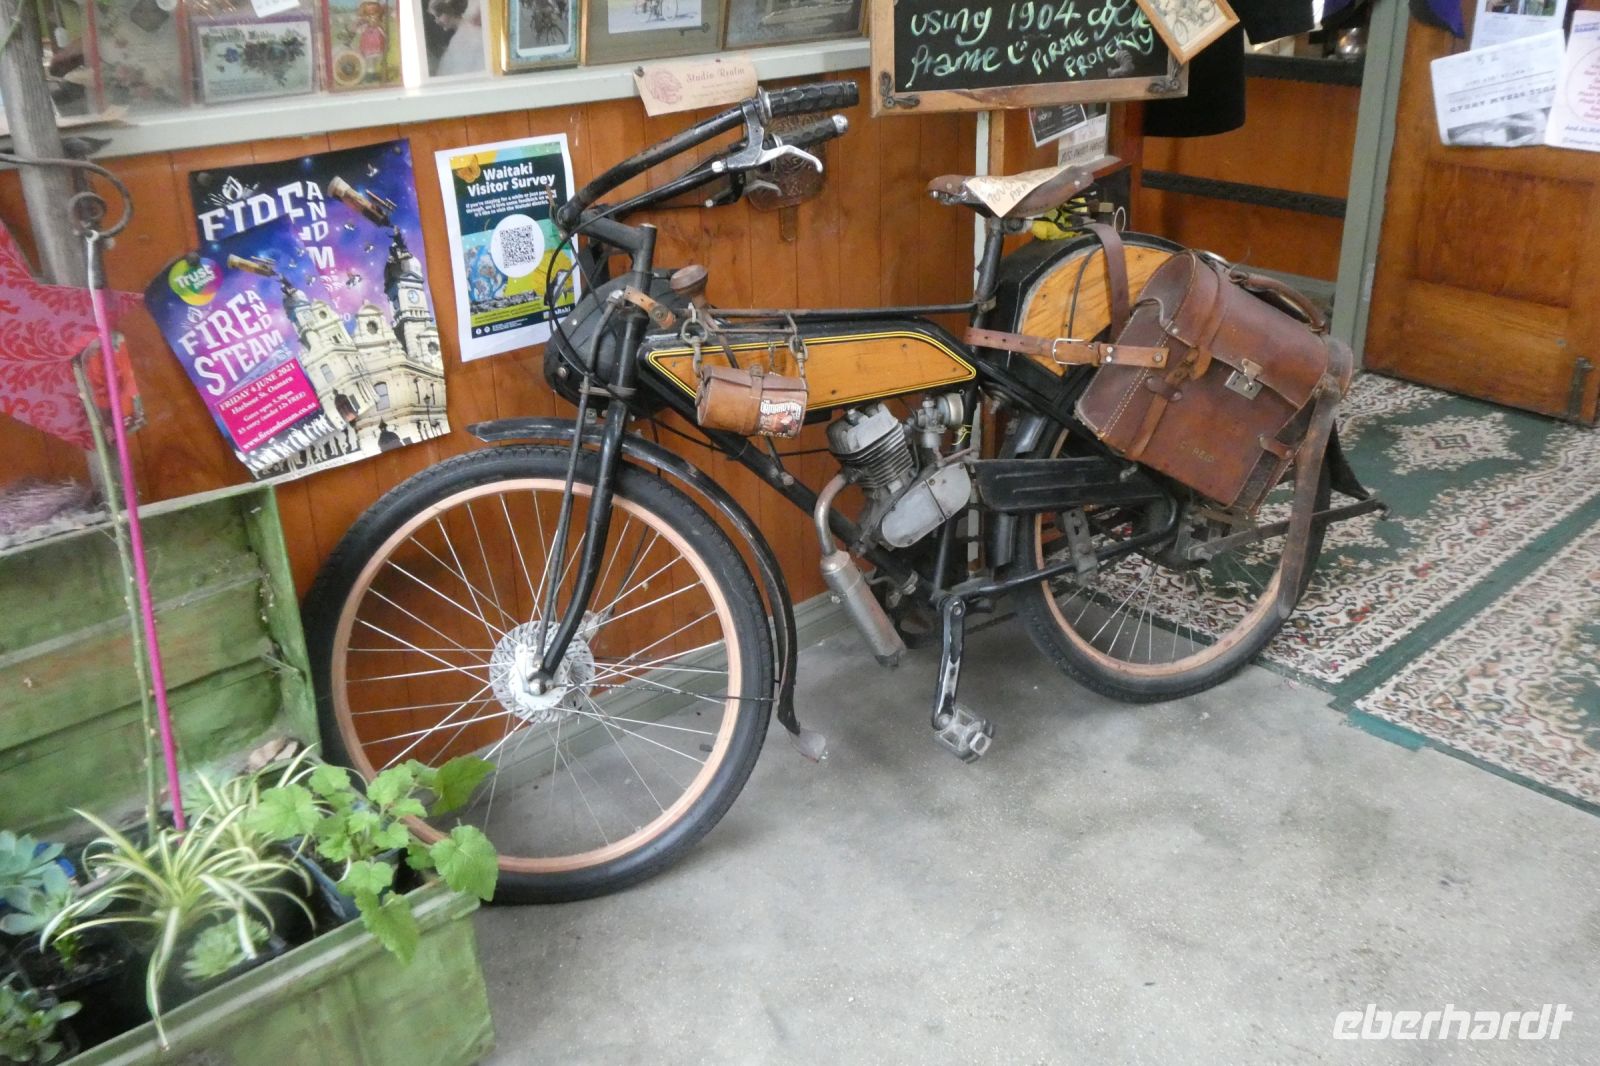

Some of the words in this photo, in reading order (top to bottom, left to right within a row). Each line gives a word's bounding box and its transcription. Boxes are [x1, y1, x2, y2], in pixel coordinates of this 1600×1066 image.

[911, 7, 992, 46] using
[1008, 0, 1081, 30] 1904
[905, 45, 1001, 88] frame
[1032, 28, 1088, 75] PIRATE
[1064, 26, 1154, 77] PROPERTY
[467, 181, 509, 197] Visitor
[511, 174, 555, 189] Survey
[483, 162, 533, 180] Waitaki
[178, 293, 262, 355] FIRE
[194, 329, 283, 396] STEAM
[220, 388, 250, 411] FRIDAY
[256, 373, 277, 391] JUNE
[277, 362, 295, 377] 2021
[231, 396, 259, 415] Harbour
